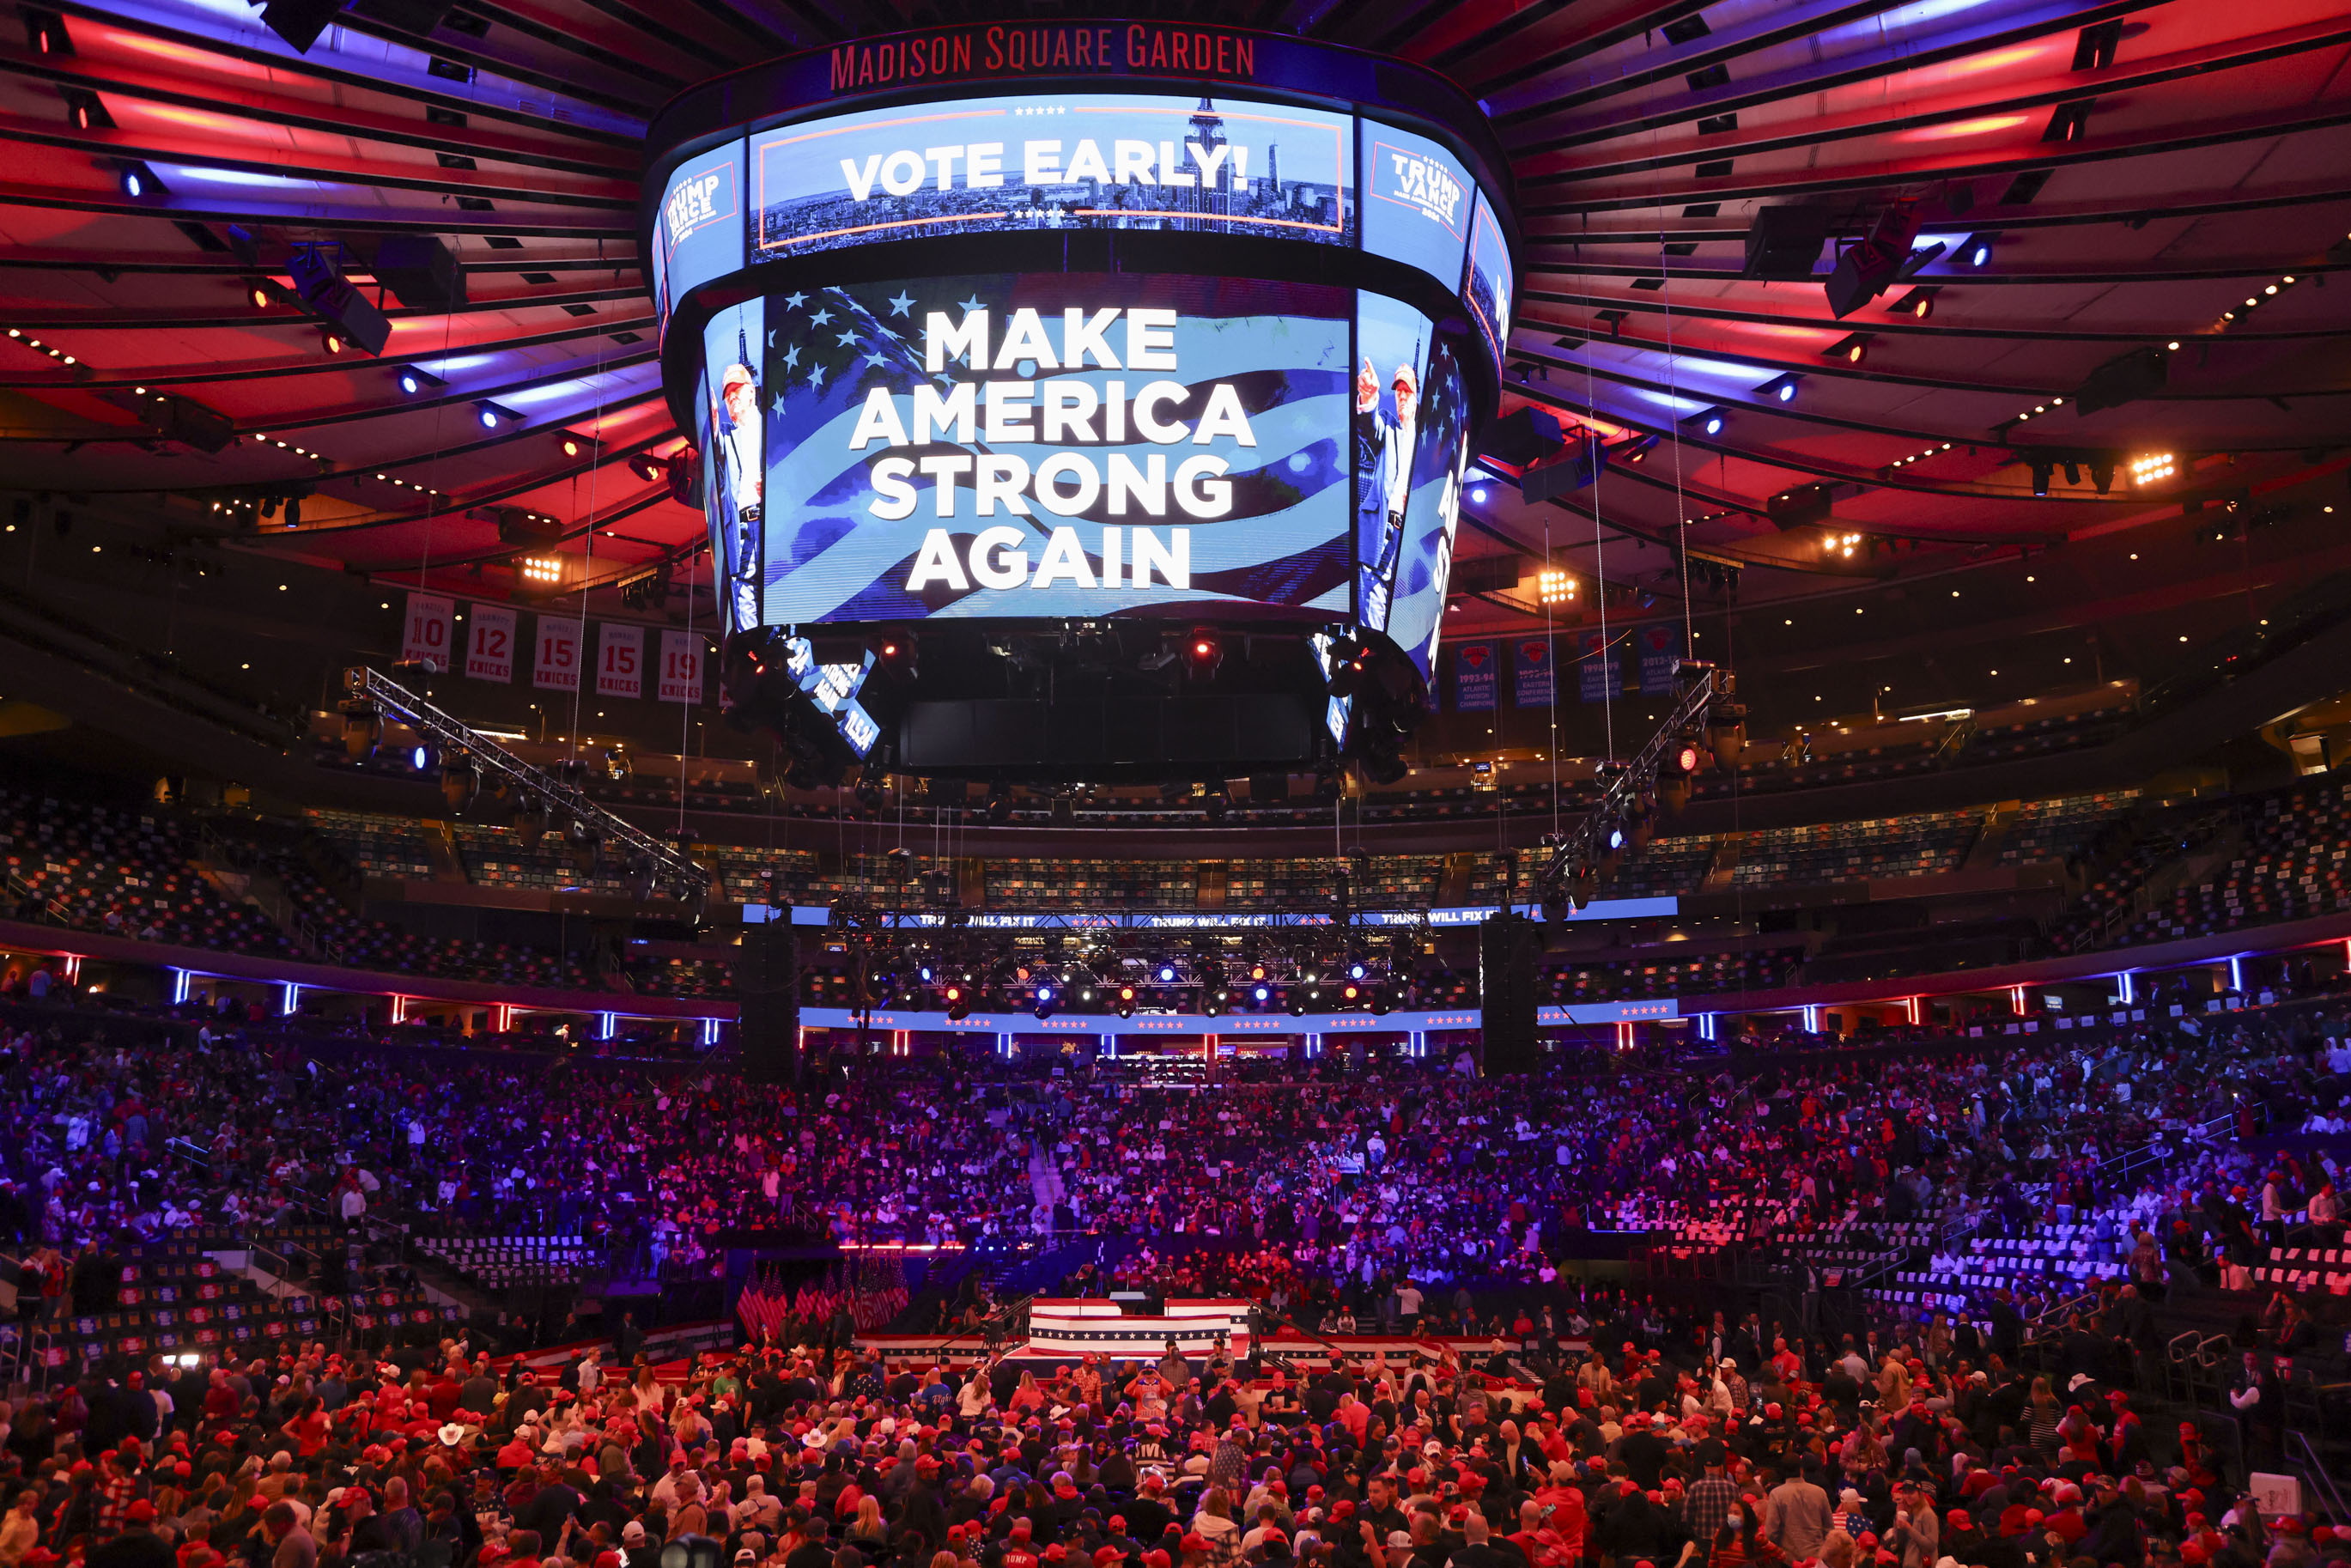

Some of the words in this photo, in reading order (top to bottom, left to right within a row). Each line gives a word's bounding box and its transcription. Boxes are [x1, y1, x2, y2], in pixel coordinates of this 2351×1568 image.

[829, 33, 972, 91] MADISON
[985, 26, 1112, 72] SQUARE
[1126, 23, 1254, 77] GARDEN
[840, 141, 1004, 202] VOTE
[1023, 138, 1249, 191] EARLY!
[1391, 153, 1461, 203] TRUMP
[1400, 174, 1455, 219] VANCE
[926, 307, 1177, 372] MAKE
[848, 380, 1258, 450] AMERICA
[867, 451, 1233, 521] STRONG
[904, 525, 1191, 592] AGAIN
[411, 617, 444, 647] 10
[476, 627, 507, 659] 12
[543, 638, 574, 667] 15
[605, 645, 635, 674] 15
[666, 652, 696, 680] 19
[468, 659, 509, 678] KNICKS
[536, 670, 577, 686] KNICKS
[1459, 672, 1495, 684] 1993-94
[599, 677, 639, 693] KNICKS
[660, 684, 700, 699] KNICKS
[1462, 684, 1491, 693] ATLANTIC
[1023, 916, 1036, 927] IT
[1151, 917, 1194, 927] TRUMP
[1197, 917, 1229, 927] WILL
[1230, 916, 1251, 927] FIX
[1253, 916, 1266, 927] IT
[1427, 911, 1461, 923] WILL
[1461, 910, 1483, 921] FIX
